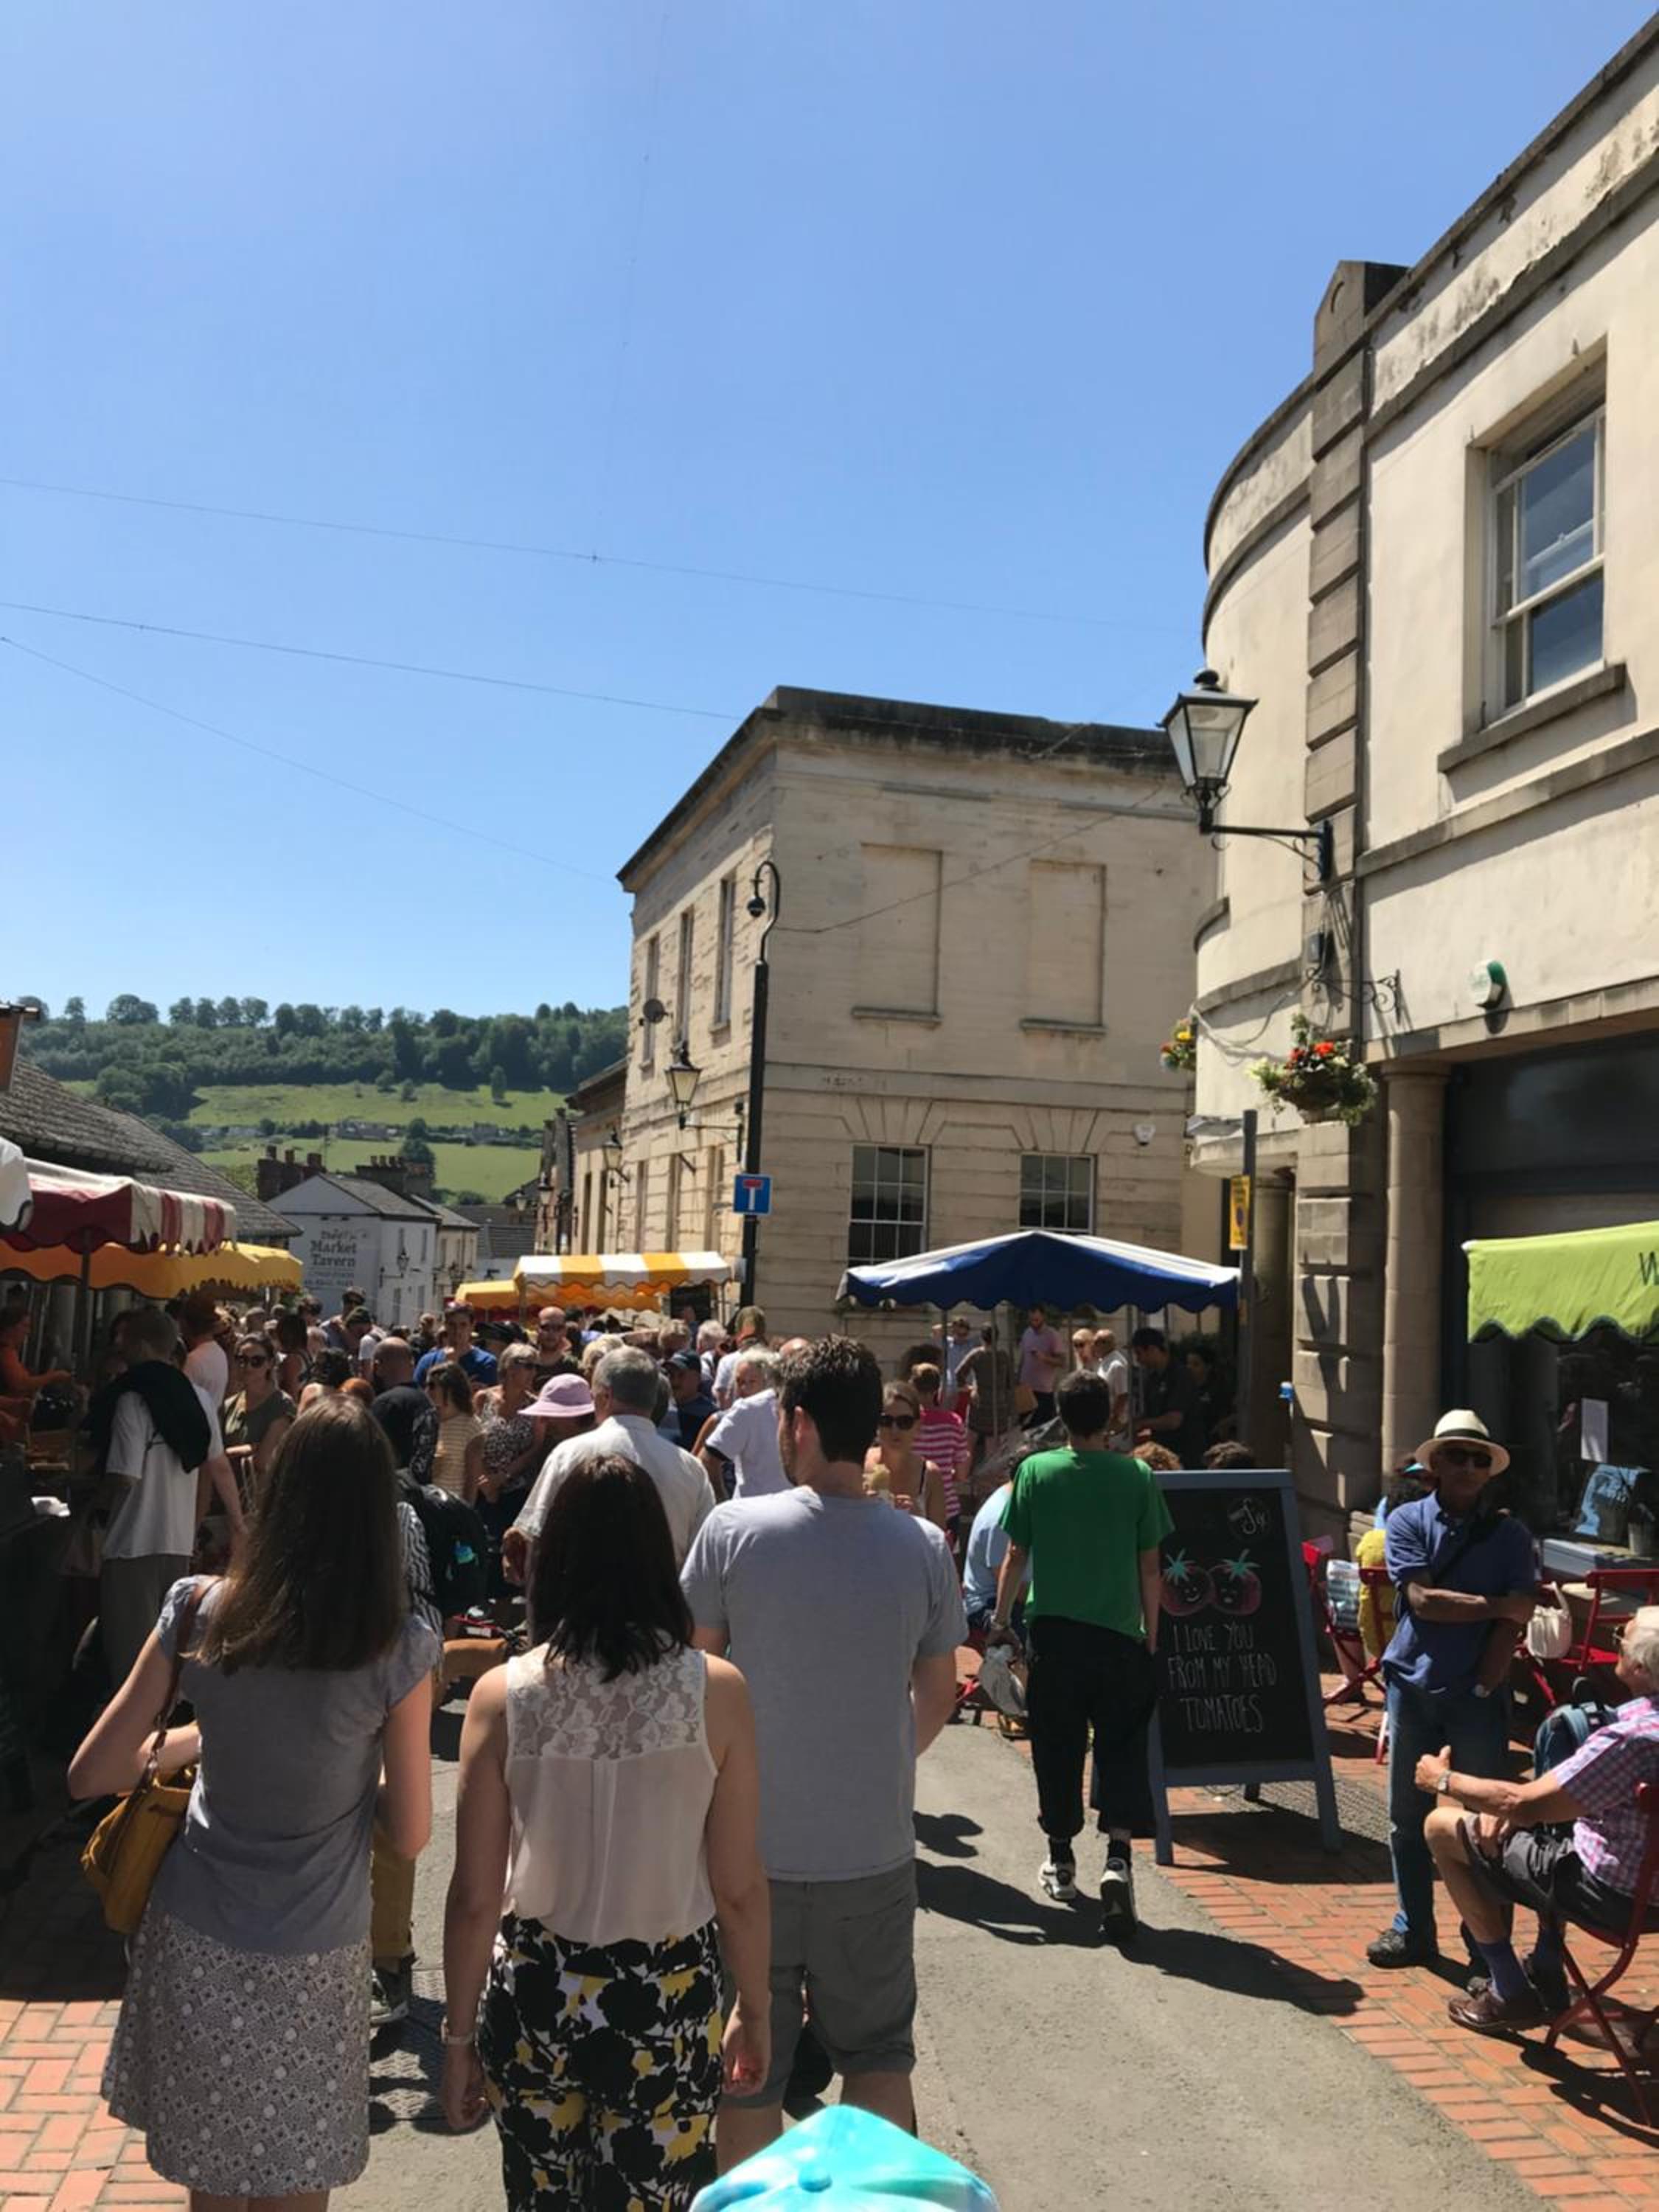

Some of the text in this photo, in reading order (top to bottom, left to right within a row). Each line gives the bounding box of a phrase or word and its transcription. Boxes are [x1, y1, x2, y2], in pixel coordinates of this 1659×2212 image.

[310, 1240, 357, 1253] Market
[312, 1253, 355, 1267] Tavern
[1173, 1622, 1254, 1652] I LOVE YOU
[1168, 1653, 1277, 1689] FROM MY HEAD
[1180, 1694, 1263, 1733] TOMATOES
